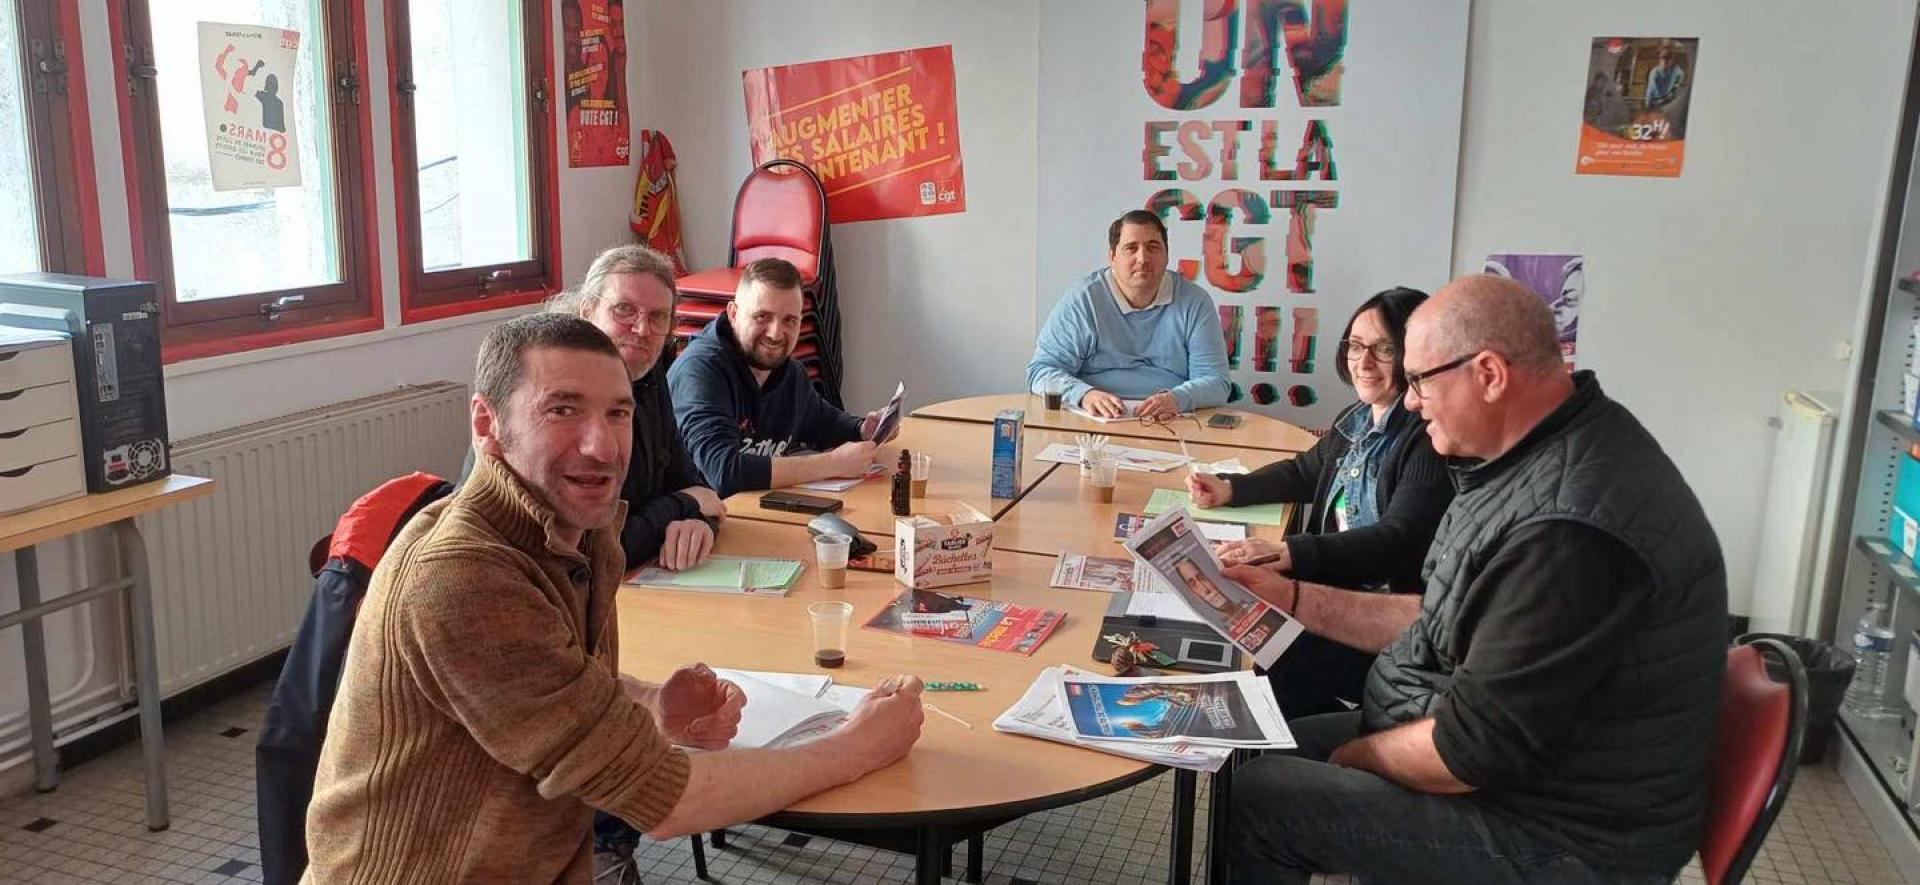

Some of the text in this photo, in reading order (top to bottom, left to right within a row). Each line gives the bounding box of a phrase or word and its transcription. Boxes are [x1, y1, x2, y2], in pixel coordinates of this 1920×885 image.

[1142, 0, 1349, 111] UN
[580, 109, 599, 126] VOTE
[600, 109, 613, 127] CGT
[770, 84, 913, 149] AUGMENTER
[811, 104, 926, 158] SALAIRES
[938, 122, 945, 145] !
[1143, 120, 1339, 181] EST LA
[1144, 188, 1339, 293] CGT
